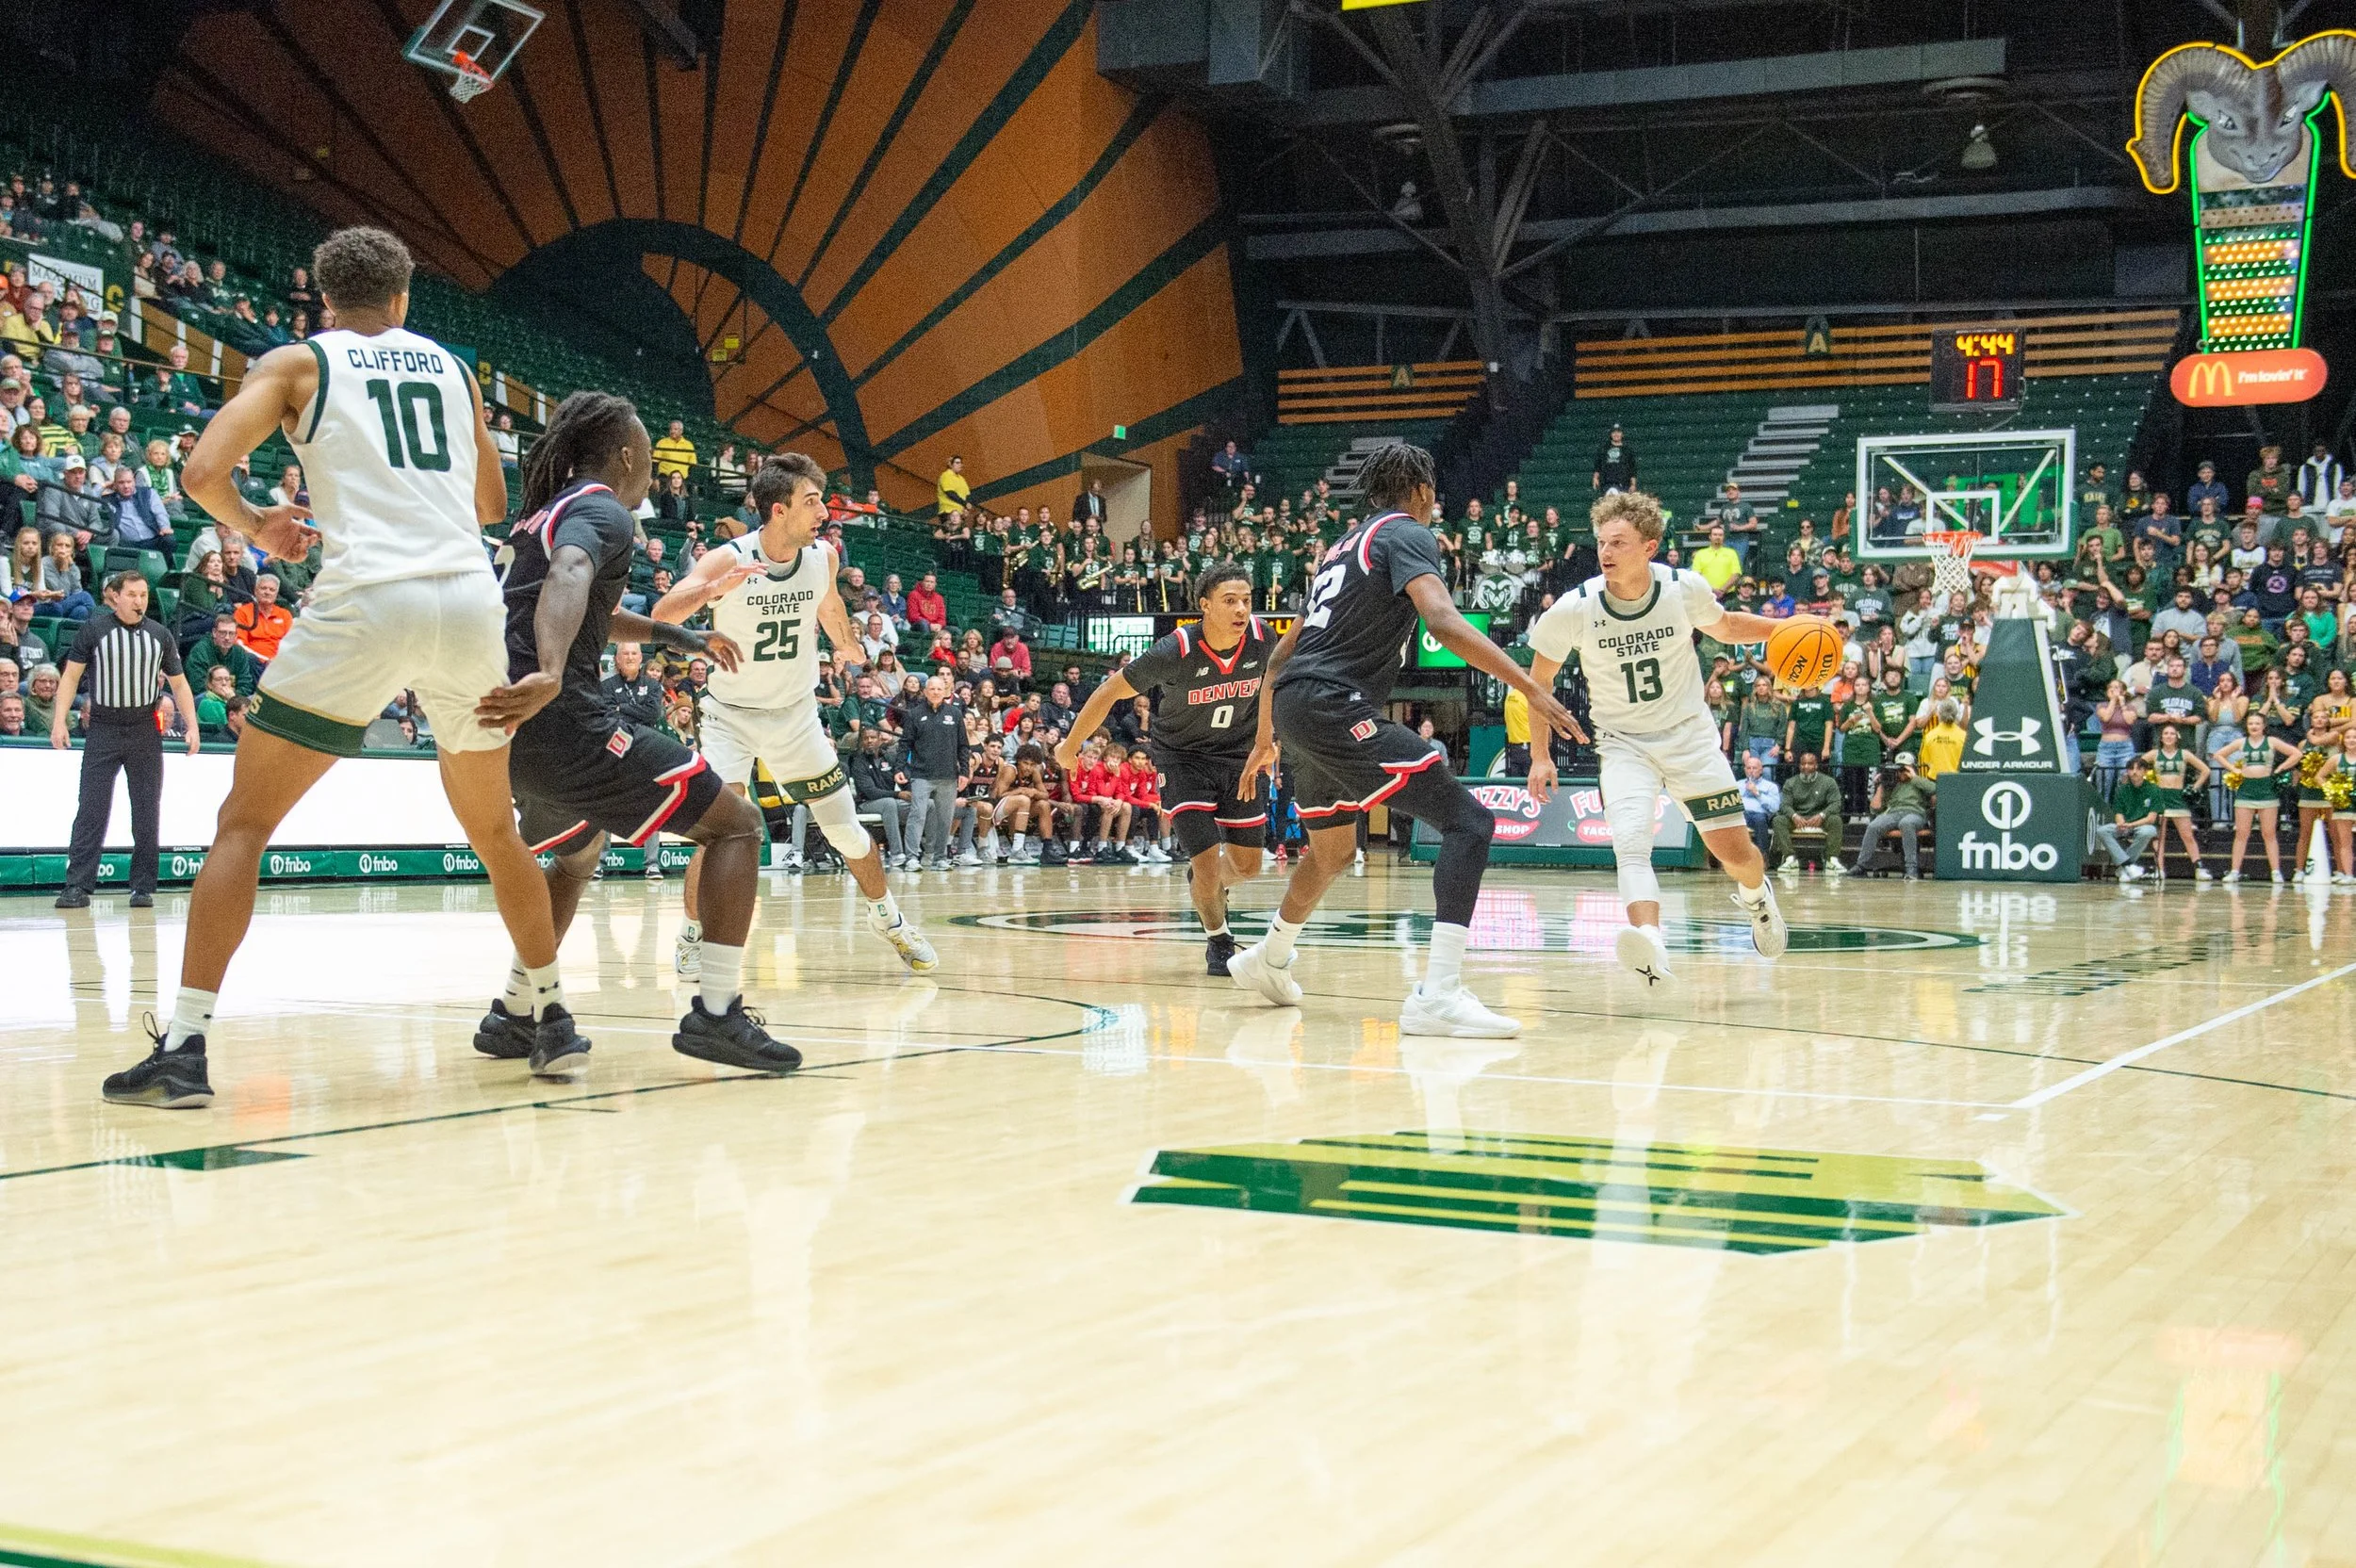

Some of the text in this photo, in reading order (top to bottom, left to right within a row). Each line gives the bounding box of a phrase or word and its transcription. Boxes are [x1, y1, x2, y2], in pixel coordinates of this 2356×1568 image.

[1808, 332, 1827, 352] A
[1955, 334, 2015, 356] 4:44
[348, 349, 444, 374] CLIFFORD
[1966, 359, 2004, 399] 17
[366, 379, 451, 472] 10
[747, 590, 813, 606] COLORADO
[761, 603, 800, 615] STATE
[753, 618, 801, 662] 25
[1598, 626, 1675, 649] COLORADO
[1616, 641, 1661, 658] STATE
[1620, 658, 1663, 704] 13
[1211, 705, 1234, 728] 0
[807, 767, 843, 793] RAMS
[1495, 825, 1530, 835] SHOP
[671, 851, 691, 865] fnbo
[1958, 831, 2057, 871] fnbo
[285, 856, 311, 873] fnbo
[373, 856, 398, 872] fnbo
[455, 855, 479, 870] fnbo
